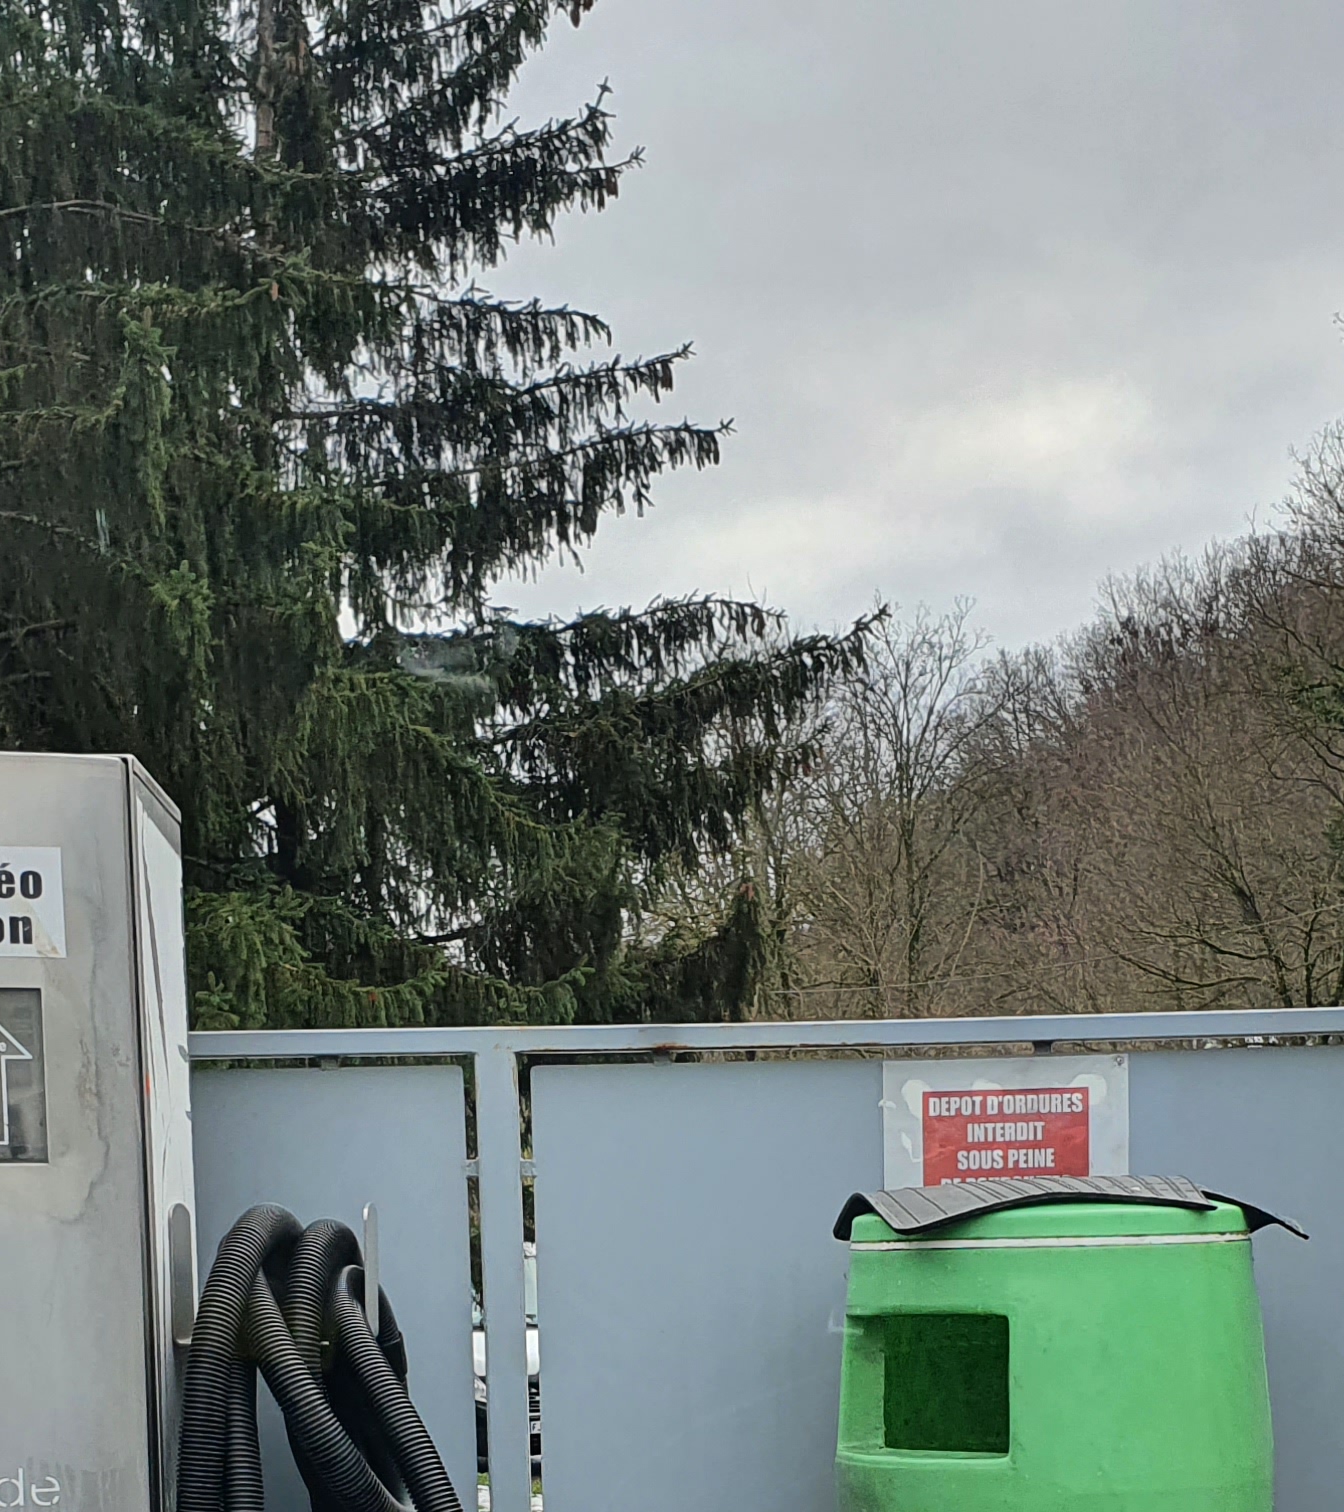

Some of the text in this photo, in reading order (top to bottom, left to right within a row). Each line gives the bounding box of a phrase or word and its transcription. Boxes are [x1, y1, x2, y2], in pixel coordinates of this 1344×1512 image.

[928, 1092, 1084, 1117] DEPOT D'ORDURES
[967, 1121, 1046, 1143] INTERDIT
[957, 1148, 1055, 1171] SOUS PEINE
